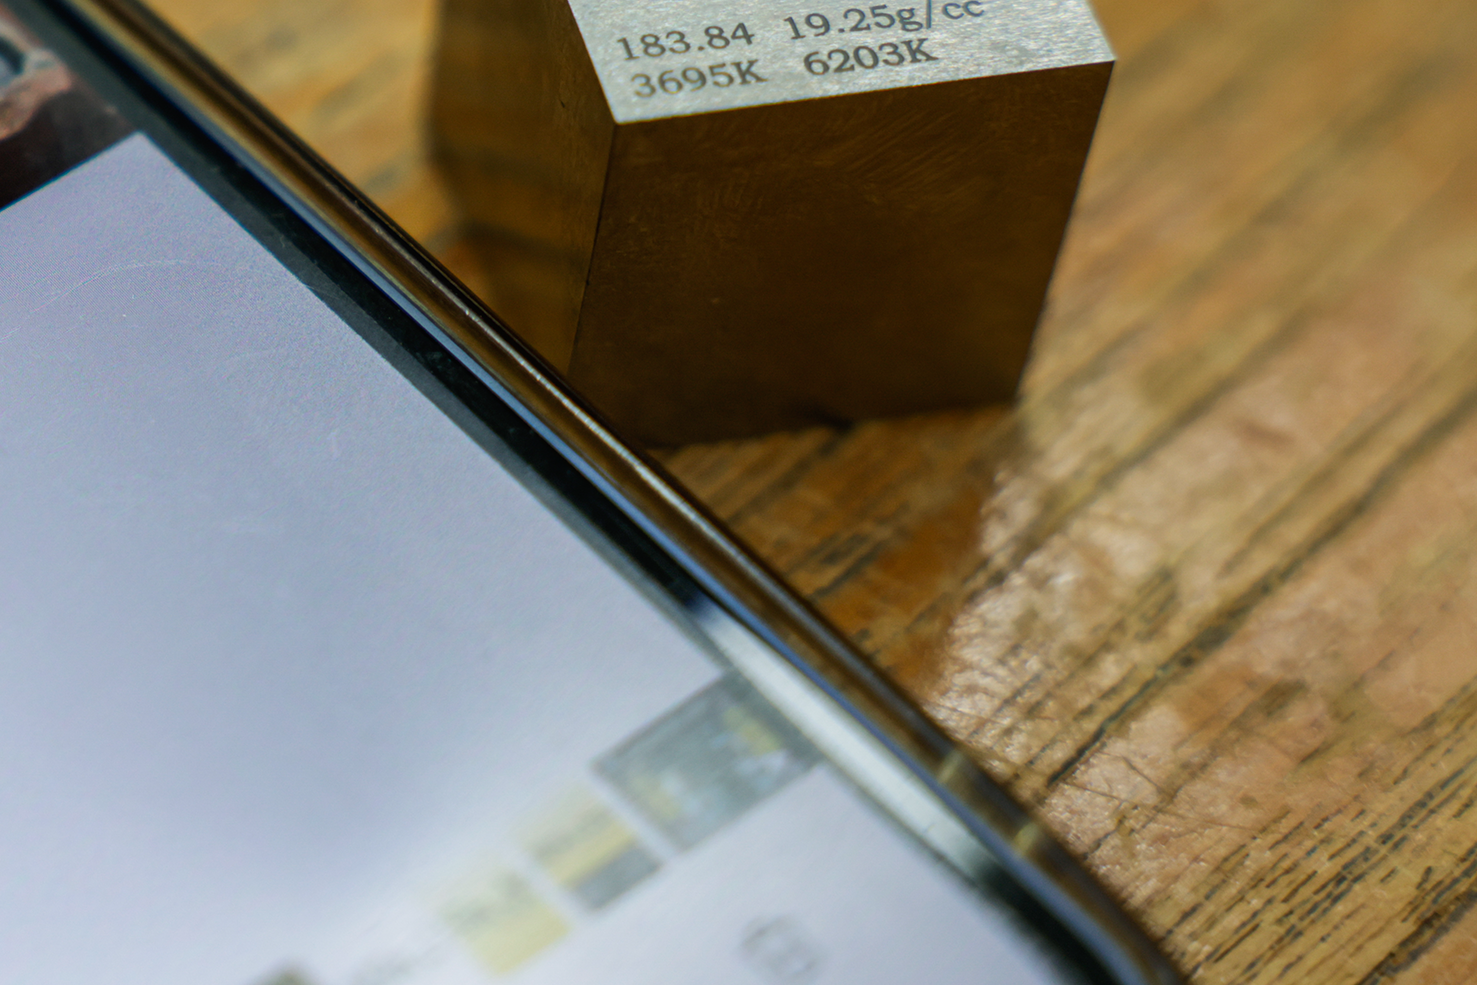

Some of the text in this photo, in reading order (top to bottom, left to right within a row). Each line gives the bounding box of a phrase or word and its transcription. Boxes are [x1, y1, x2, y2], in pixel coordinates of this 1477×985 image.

[617, 22, 756, 61] 183.84
[630, 38, 939, 99] 3695K 6203K
